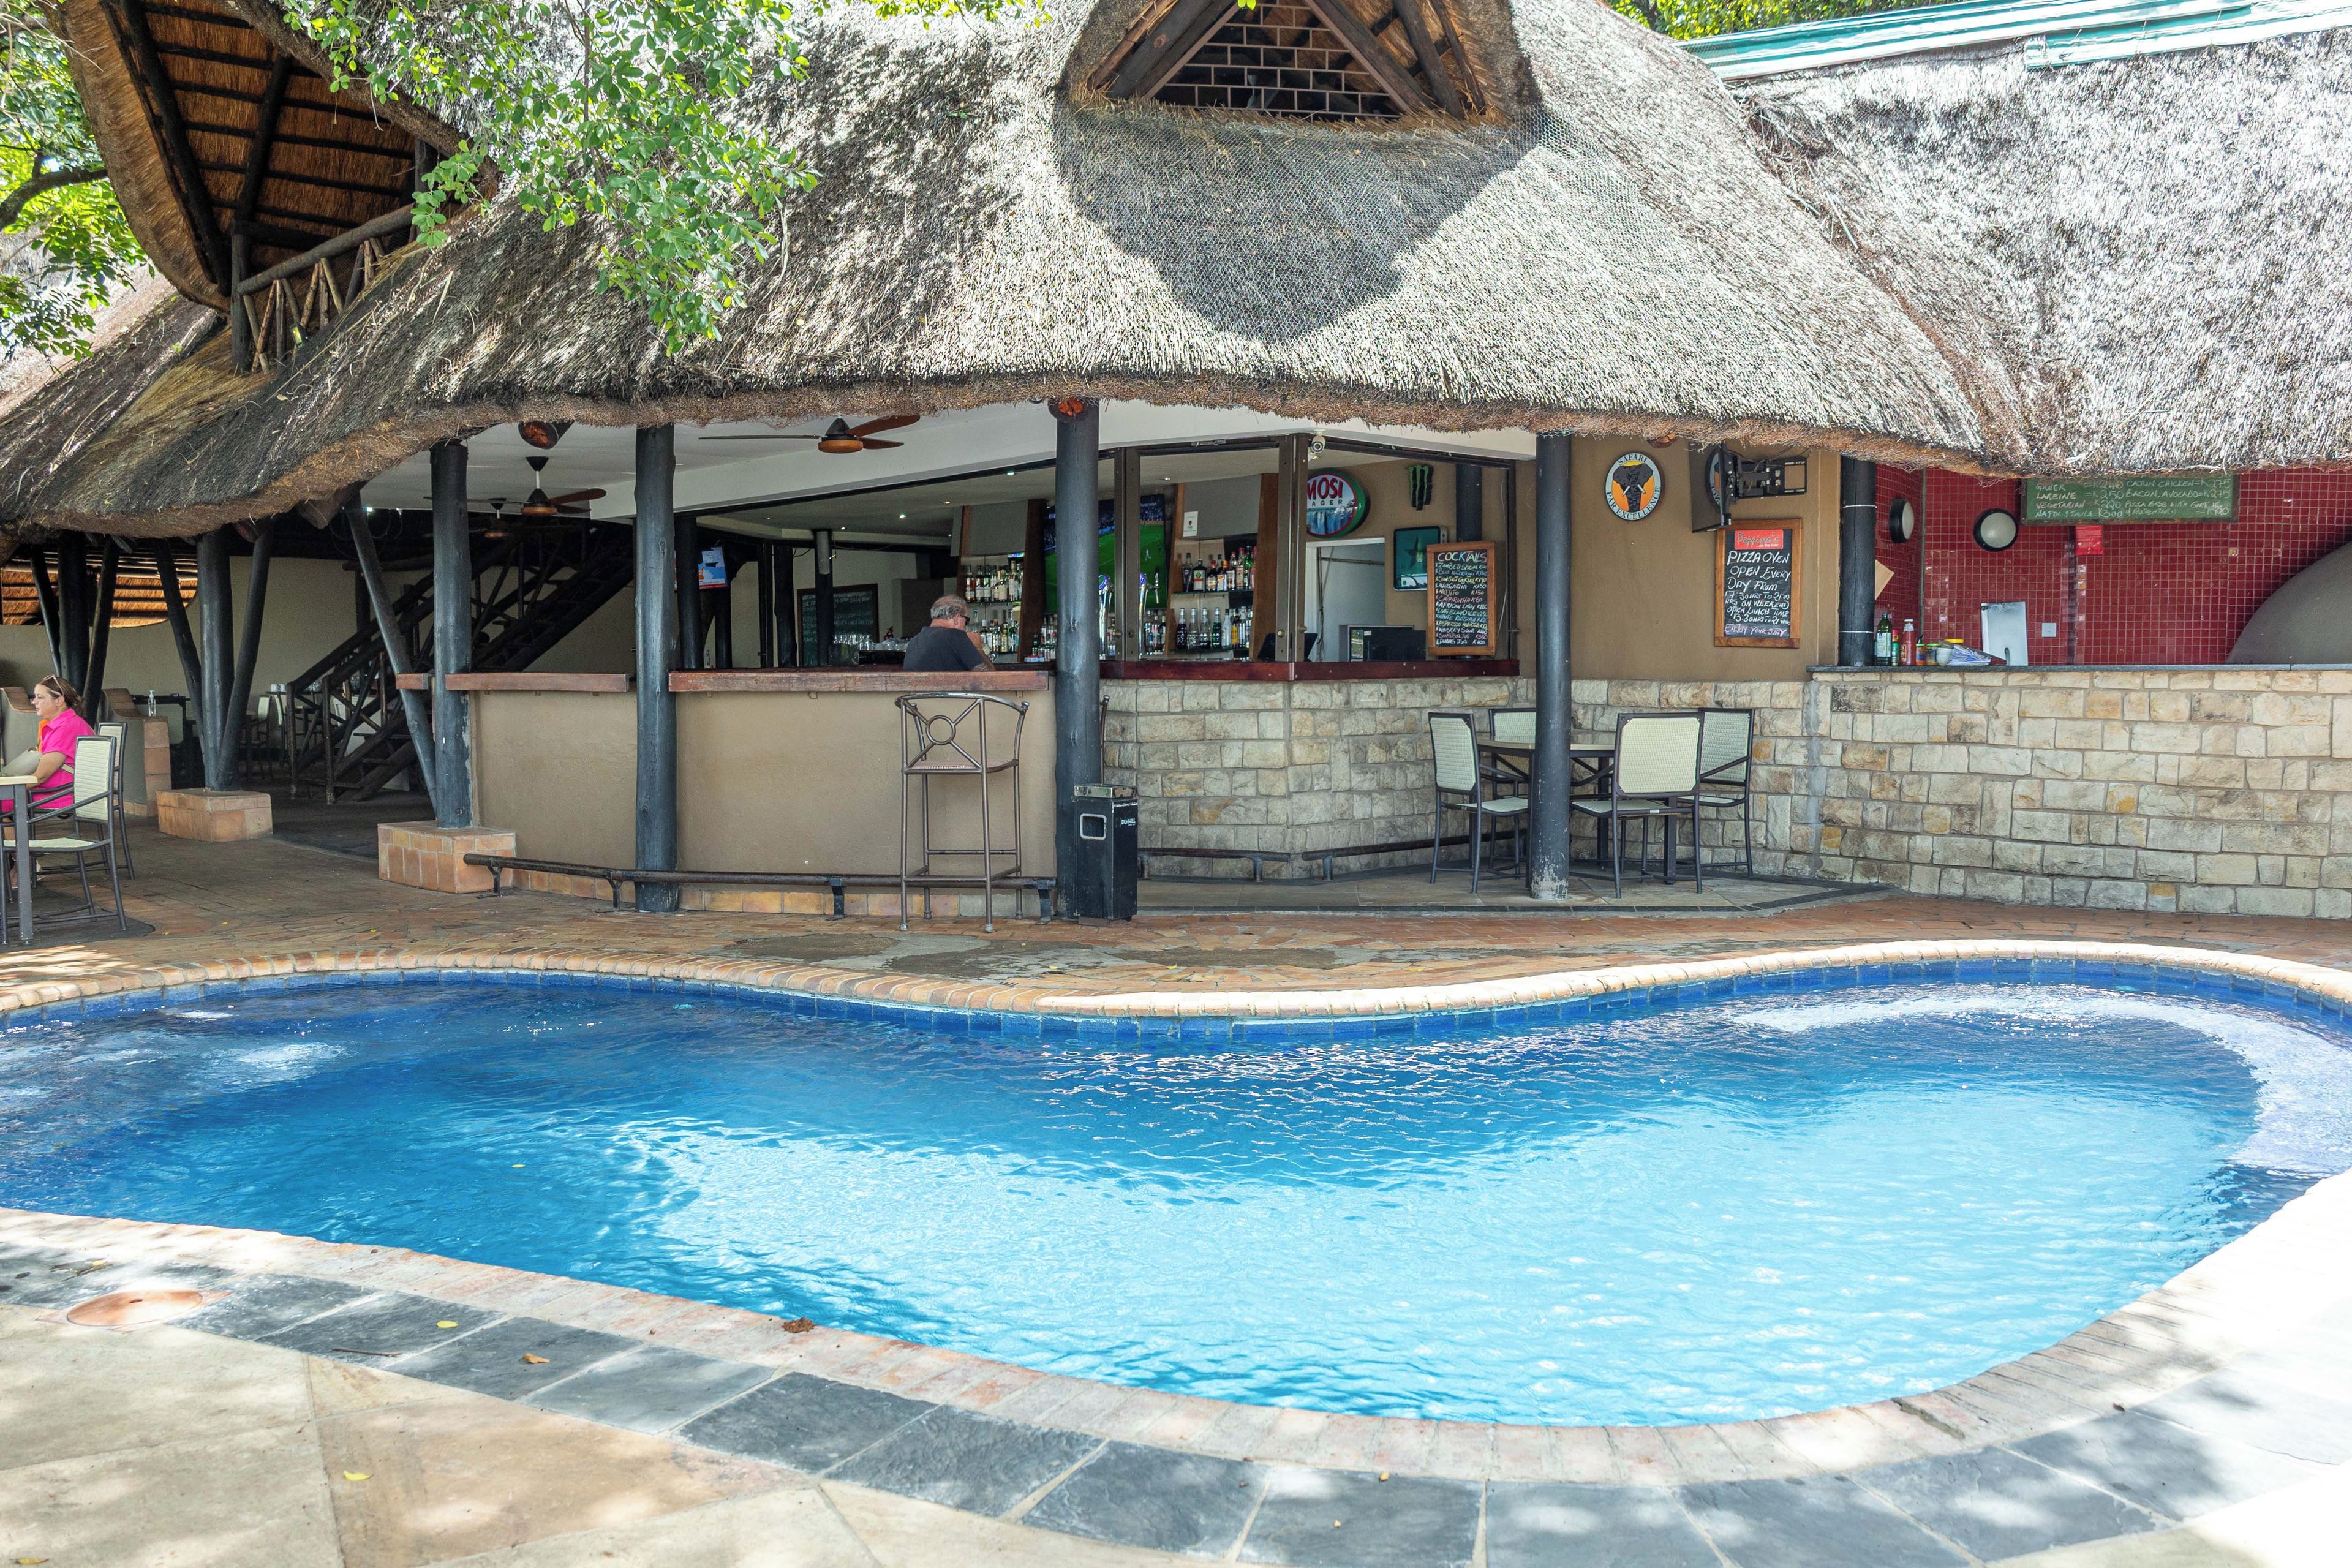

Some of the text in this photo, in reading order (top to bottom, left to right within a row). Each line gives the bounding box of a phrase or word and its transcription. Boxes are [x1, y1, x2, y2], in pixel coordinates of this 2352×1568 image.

[1618, 453, 1648, 466] SAFARI
[1307, 477, 1343, 500] MOSI
[2125, 489, 2160, 498] BACON,
[1606, 486, 1661, 519] PAR EXCELLENCE
[2036, 500, 2085, 509] VEGETARIAN
[1438, 551, 1487, 562] COCKTAILS
[1727, 551, 1790, 565] PIZZA OVEN
[1730, 566, 1791, 581] OPEN EVERY
[1727, 577, 1777, 593] DAY FROM
[1753, 600, 1790, 609] WEEKEND
[1727, 606, 1746, 616] OPEN
[1771, 607, 1790, 617] TIME
[1725, 624, 1748, 635] ENJOY
[1768, 627, 1787, 637] STAY
